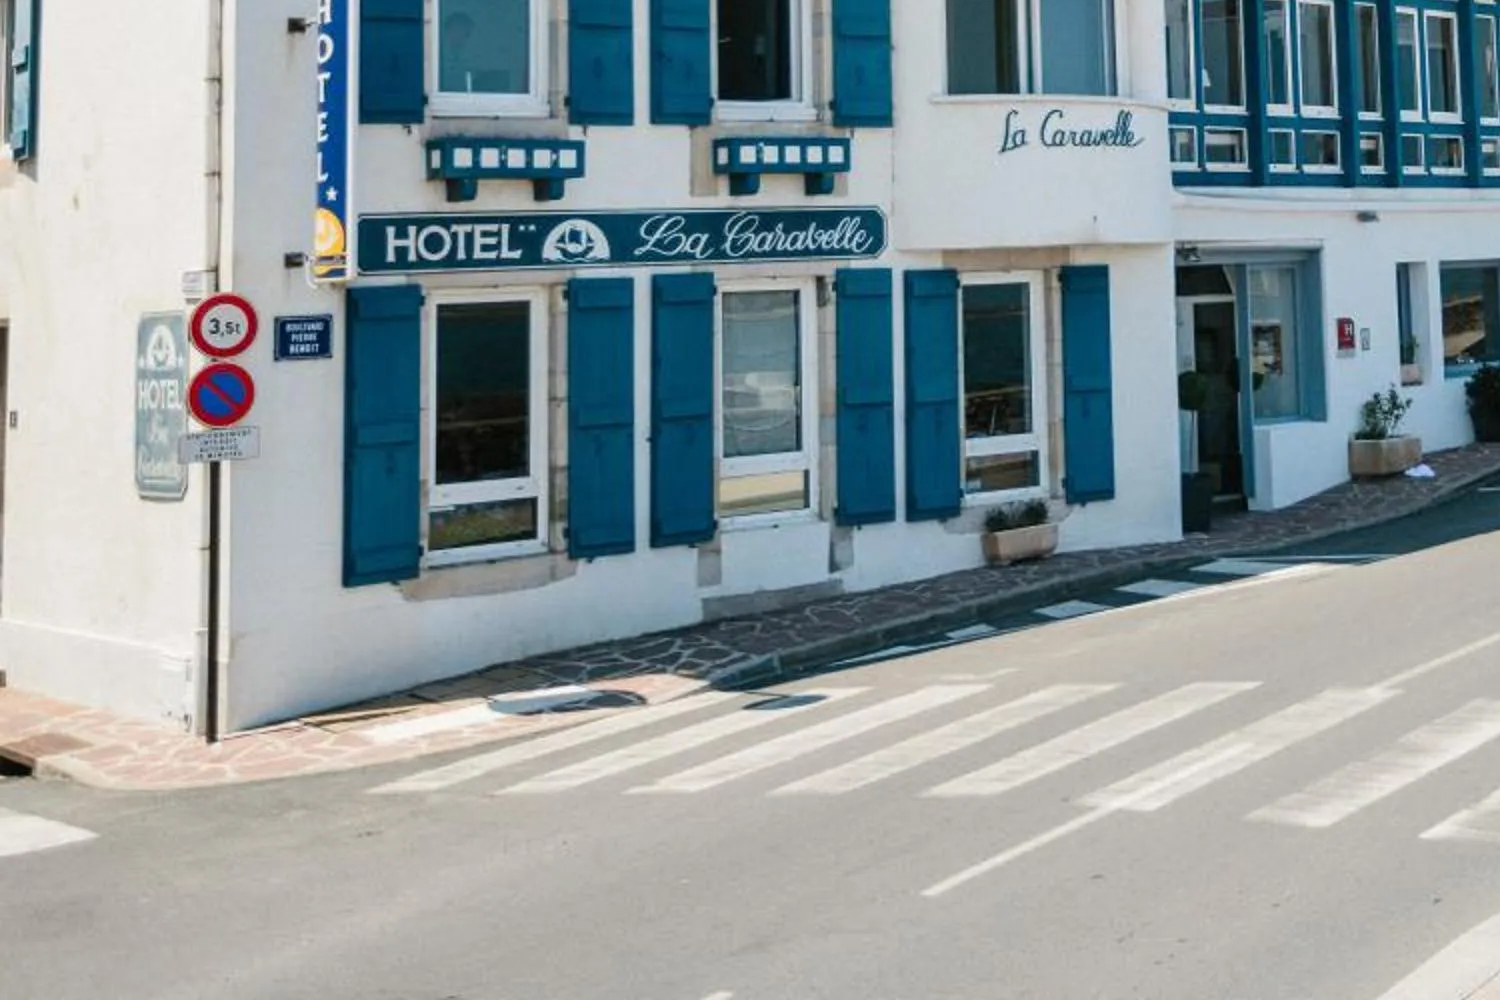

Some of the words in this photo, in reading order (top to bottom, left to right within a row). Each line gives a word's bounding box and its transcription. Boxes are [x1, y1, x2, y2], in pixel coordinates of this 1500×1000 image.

[998, 109, 1028, 154] La
[1040, 108, 1145, 147] Caravelle
[385, 223, 523, 263] HOTEL
[634, 215, 715, 259] La
[722, 210, 874, 258] Caravelle
[138, 379, 184, 410] HOTEL
